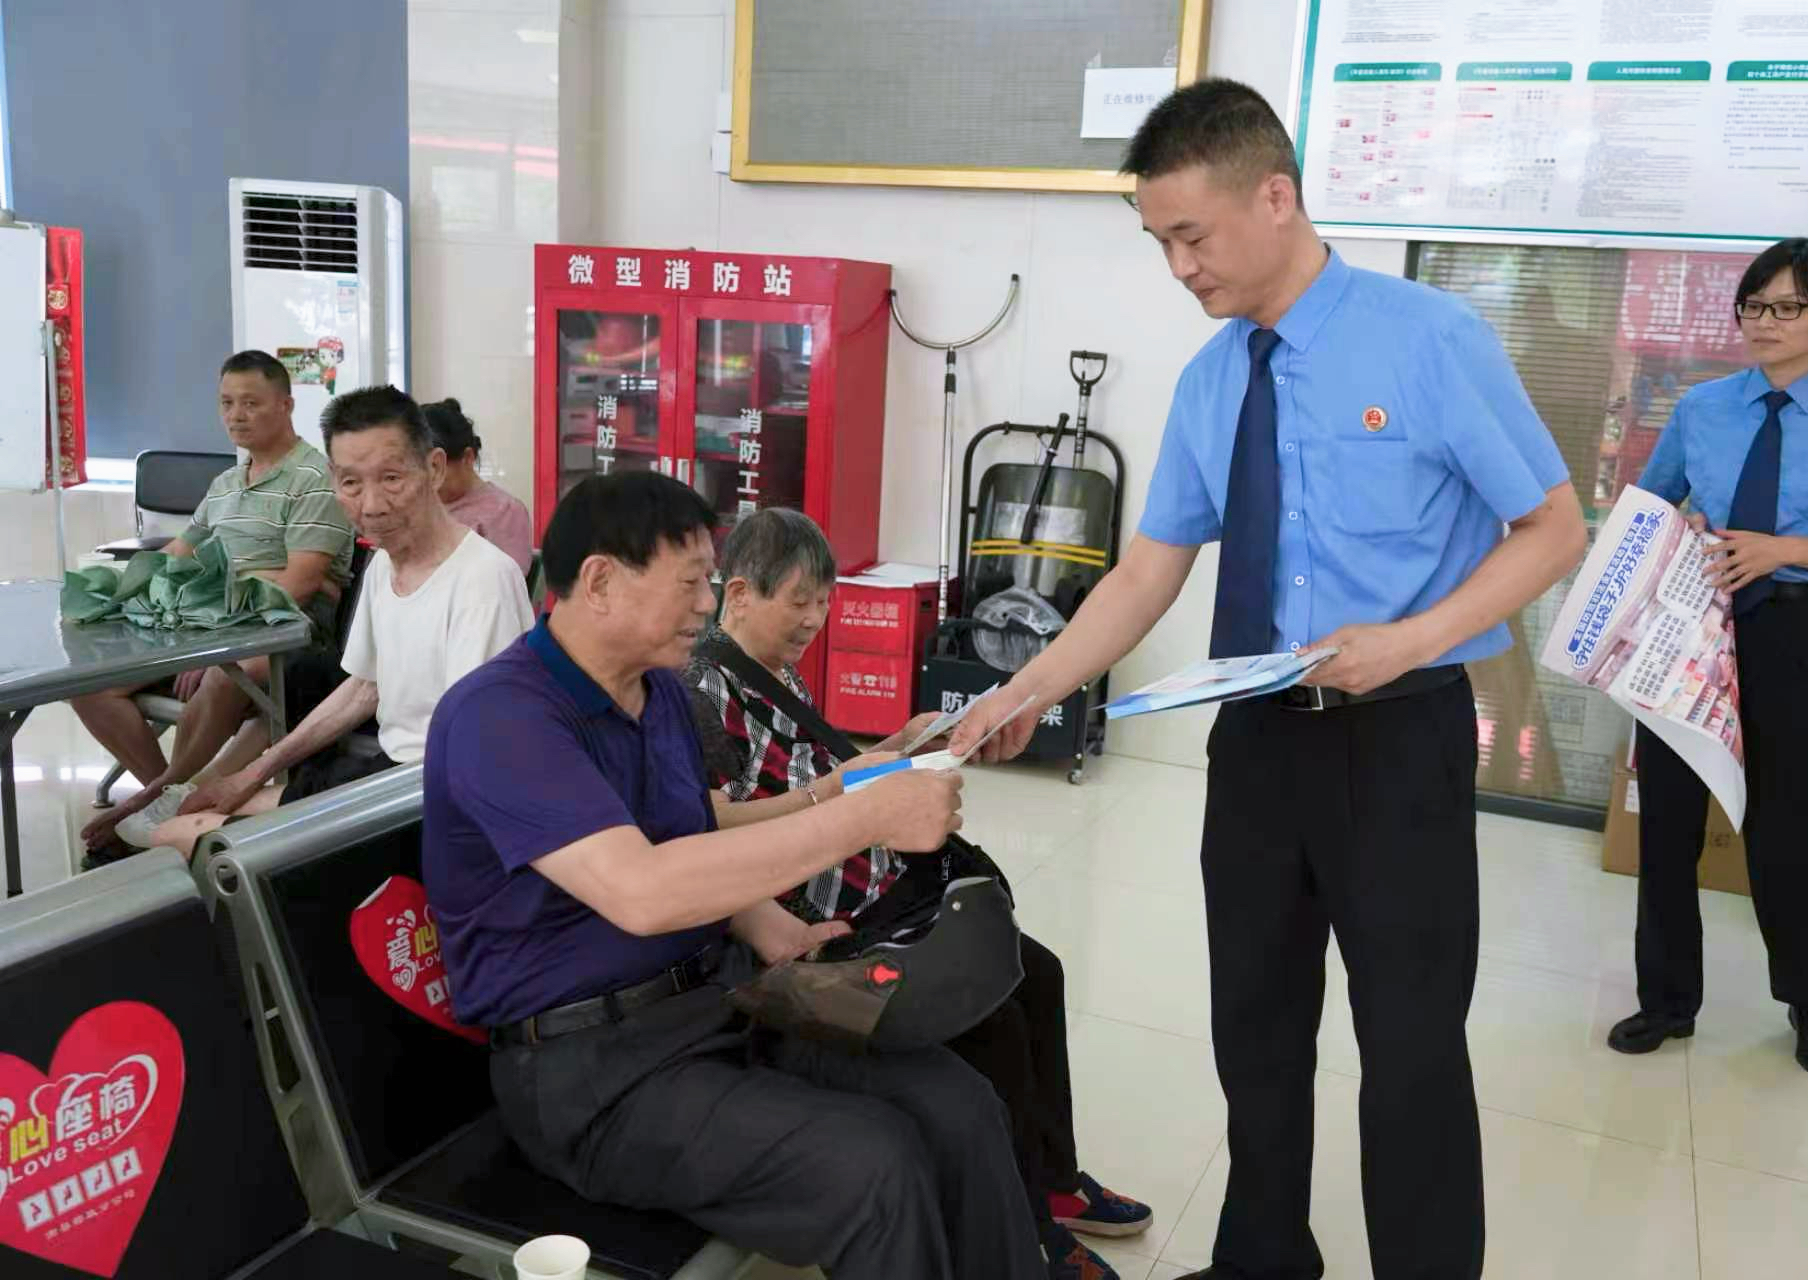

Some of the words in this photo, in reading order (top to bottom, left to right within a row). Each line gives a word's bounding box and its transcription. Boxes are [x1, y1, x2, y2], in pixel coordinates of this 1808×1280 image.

[568, 255, 793, 297] 微型消防站
[73, 1117, 123, 1153] seat
